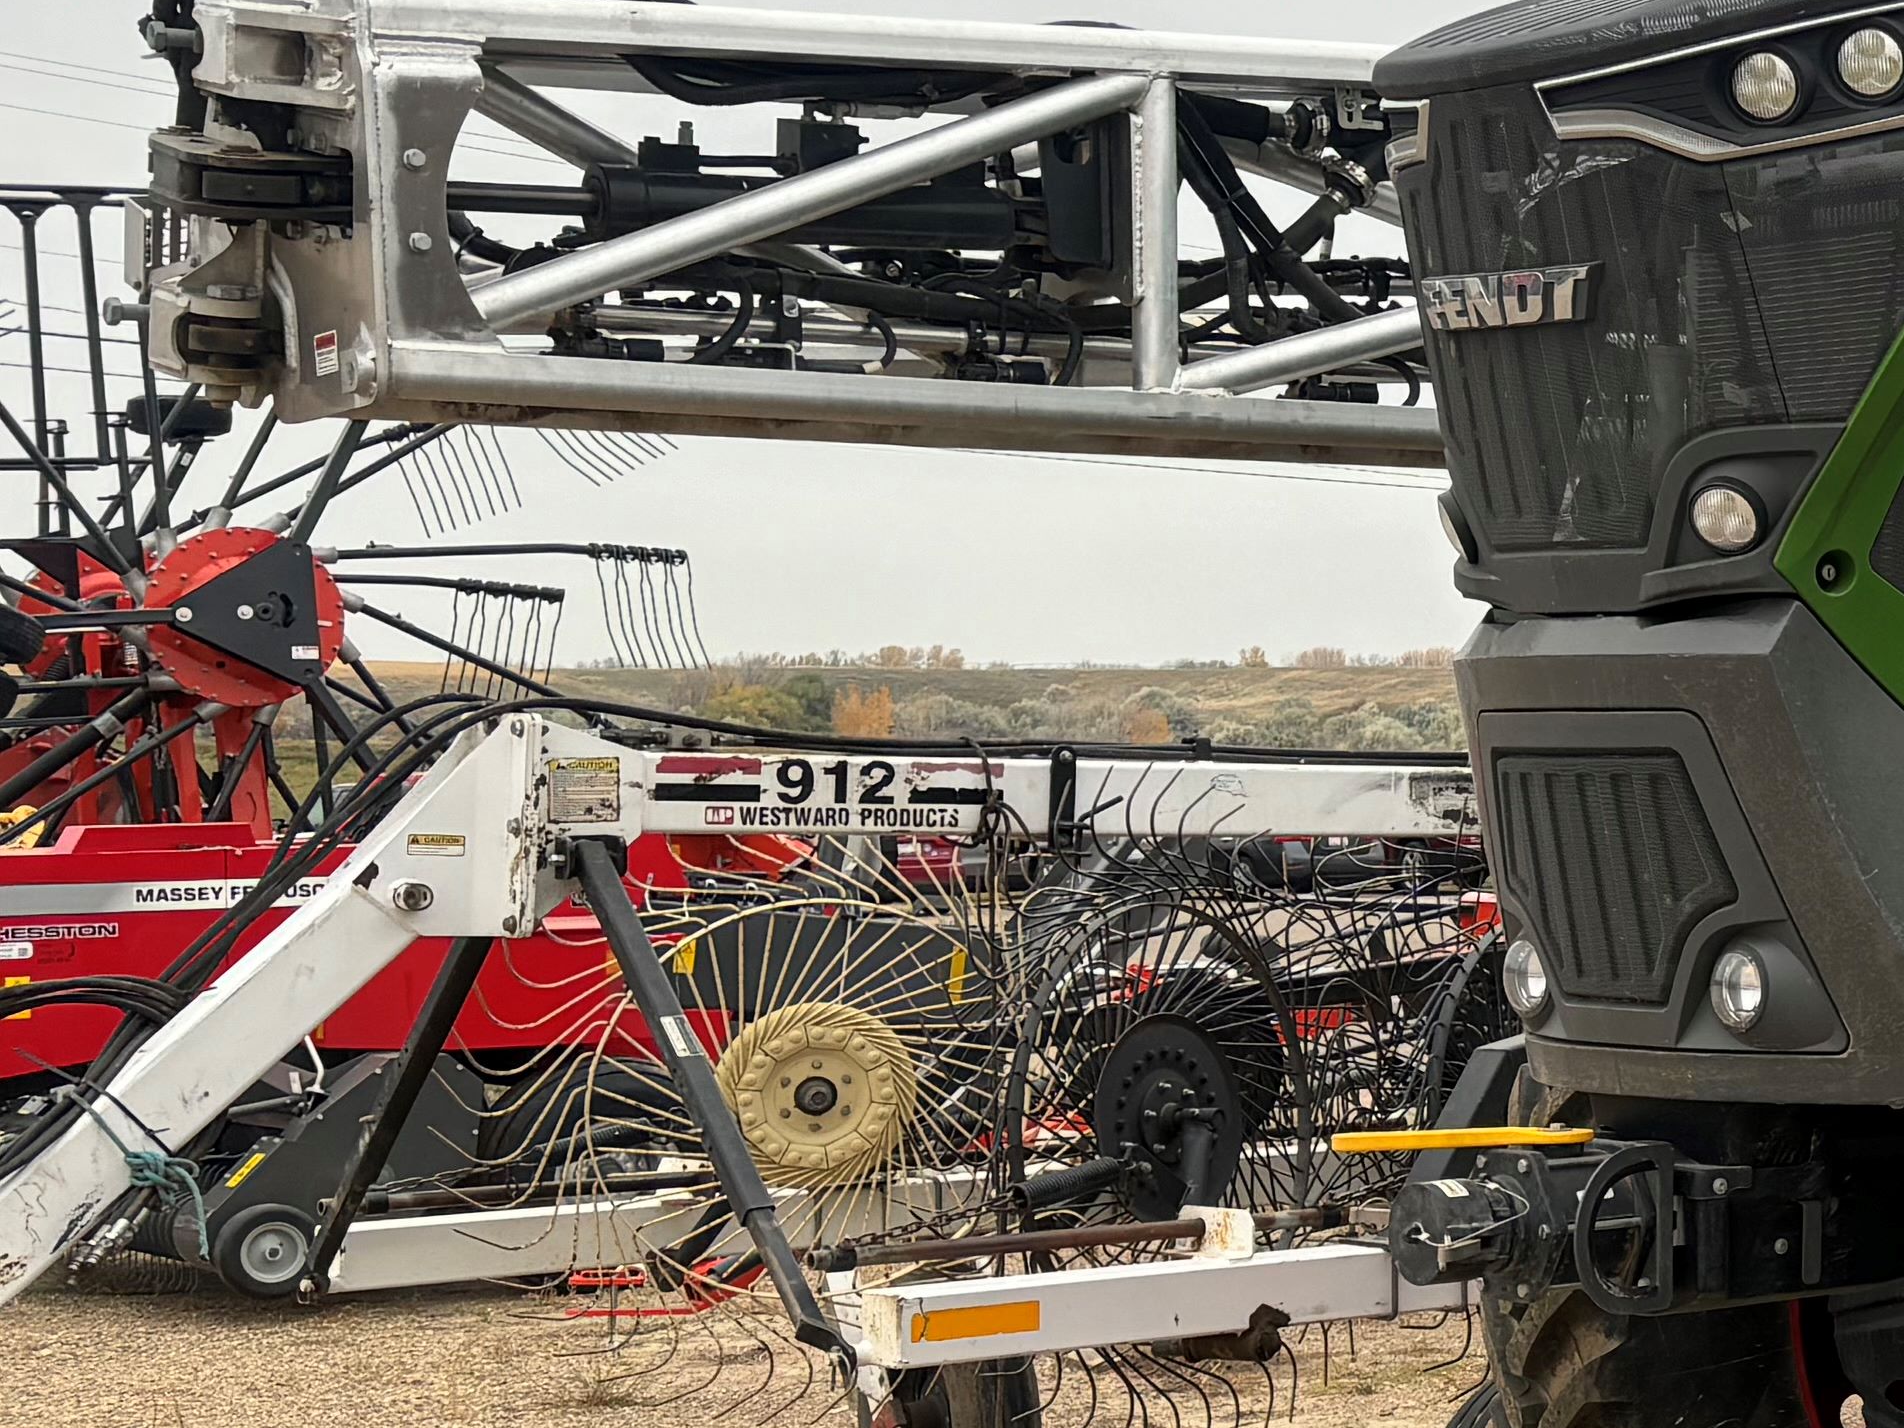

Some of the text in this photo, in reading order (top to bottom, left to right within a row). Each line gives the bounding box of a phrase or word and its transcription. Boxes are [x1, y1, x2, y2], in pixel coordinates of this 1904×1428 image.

[1421, 265, 1590, 330] FENDT
[568, 761, 613, 770] CAUTION
[776, 759, 895, 805] 912
[740, 805, 850, 827] WESTWARD
[860, 807, 960, 828] PRODUCTS
[135, 887, 223, 903] MASSEY
